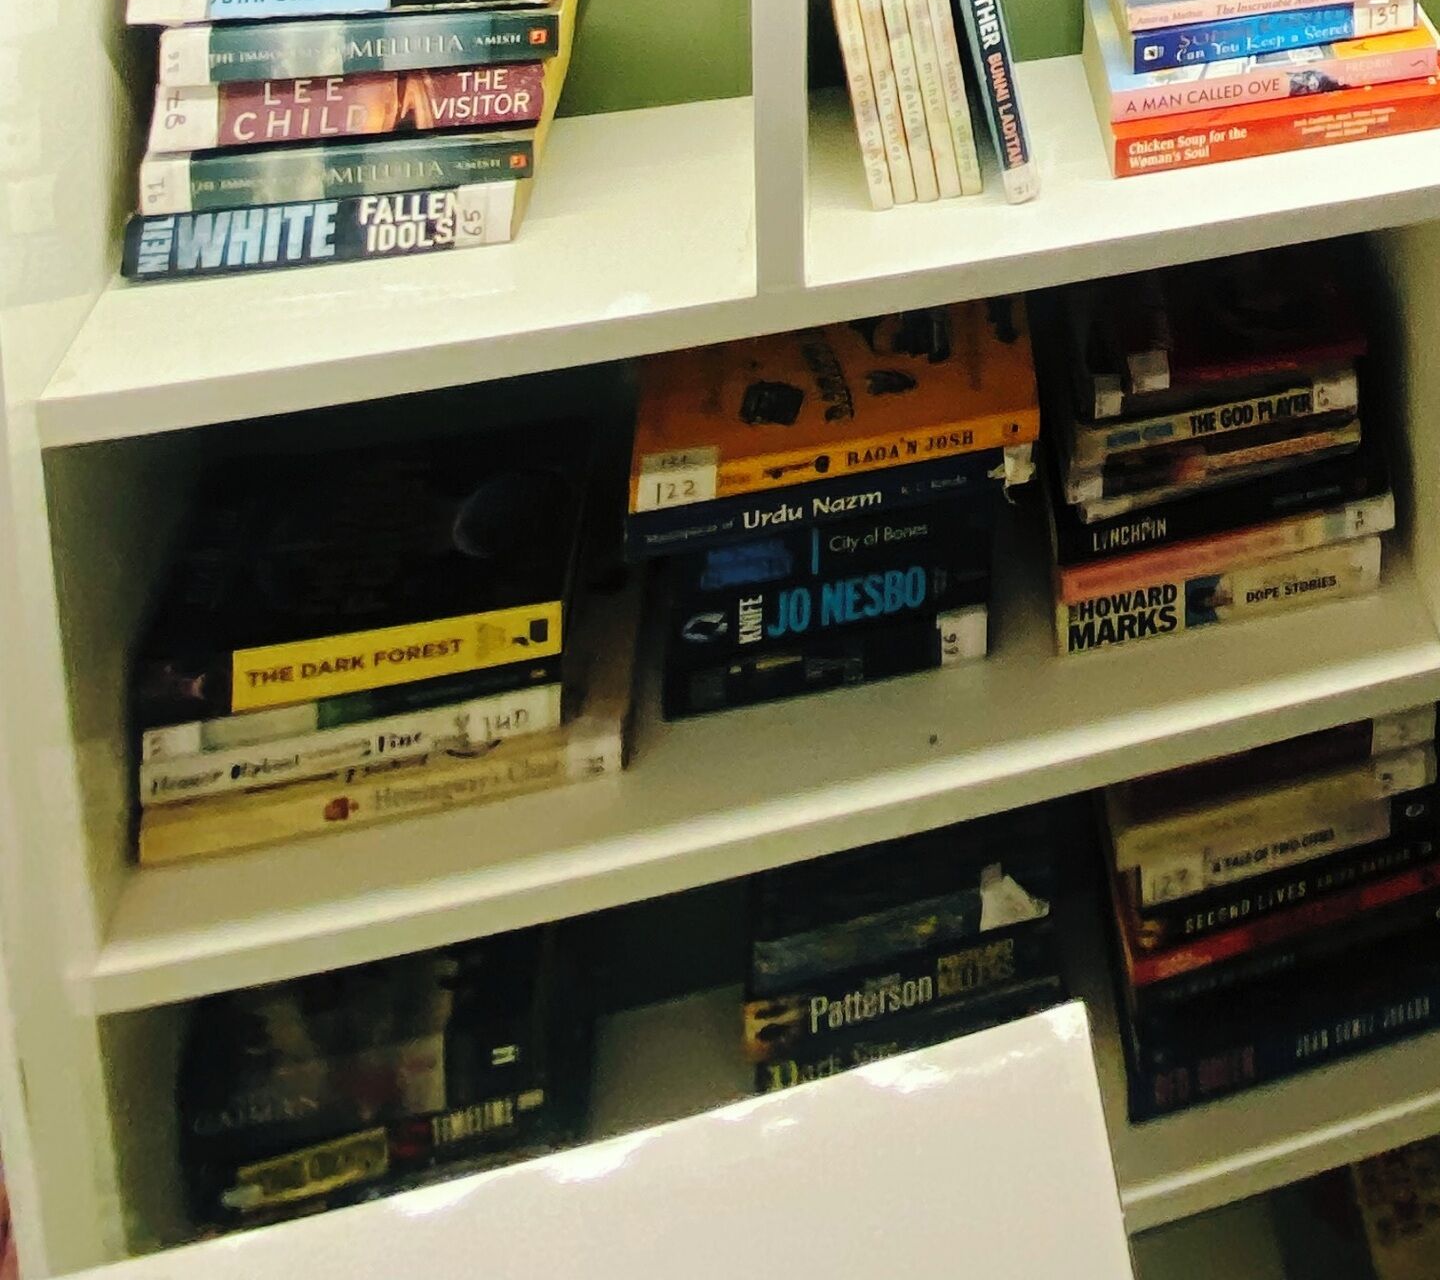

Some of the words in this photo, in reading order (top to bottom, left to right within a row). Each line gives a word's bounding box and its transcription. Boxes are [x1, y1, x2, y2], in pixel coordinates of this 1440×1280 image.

[1216, 1, 1235, 16] The
[1367, 3, 1399, 30] 139
[349, 34, 466, 59] MELUHA
[476, 33, 521, 47] AMISH
[1175, 47, 1206, 63] Can
[1211, 41, 1240, 56] You
[1246, 34, 1285, 51] Keep
[1304, 23, 1350, 41] Secret
[264, 78, 344, 106] LEE
[458, 68, 508, 92] THE
[986, 52, 1010, 103] BUNMI
[430, 94, 530, 121] VISITOR
[1125, 102, 1138, 114] A
[1142, 92, 1182, 111] MAN
[1187, 83, 1243, 104] CALLED
[1248, 78, 1281, 96] OVE
[233, 104, 368, 141] CHILD
[997, 103, 1023, 168] LADITAN
[1128, 137, 1175, 155] Chicken
[1177, 134, 1206, 151] Soup
[1208, 130, 1227, 144] for
[1228, 127, 1248, 141] the
[1129, 151, 1181, 169] Woman's
[1184, 147, 1210, 161] Soul
[358, 192, 457, 226] FALLEN
[176, 201, 338, 271] WHITE
[366, 217, 455, 253] IDOLS
[1189, 412, 1216, 436] THE
[1219, 404, 1254, 429] GOD
[1257, 392, 1312, 422] PLAYER
[655, 480, 696, 506] 122
[742, 500, 803, 530] Urdu
[812, 488, 883, 515] Nazm
[829, 535, 859, 554] City
[1078, 583, 1178, 623] HOWARD
[1246, 585, 1280, 604] DOPE
[1284, 574, 1337, 597] STORIES
[768, 587, 811, 638] JO
[1067, 605, 1178, 653] MARKS
[247, 665, 294, 688] THE
[300, 655, 366, 680] DARK
[373, 639, 464, 667] FOREST
[1185, 899, 1251, 933] SECOND
[1257, 882, 1307, 911] LIVES
[809, 973, 933, 1035] Patterson
